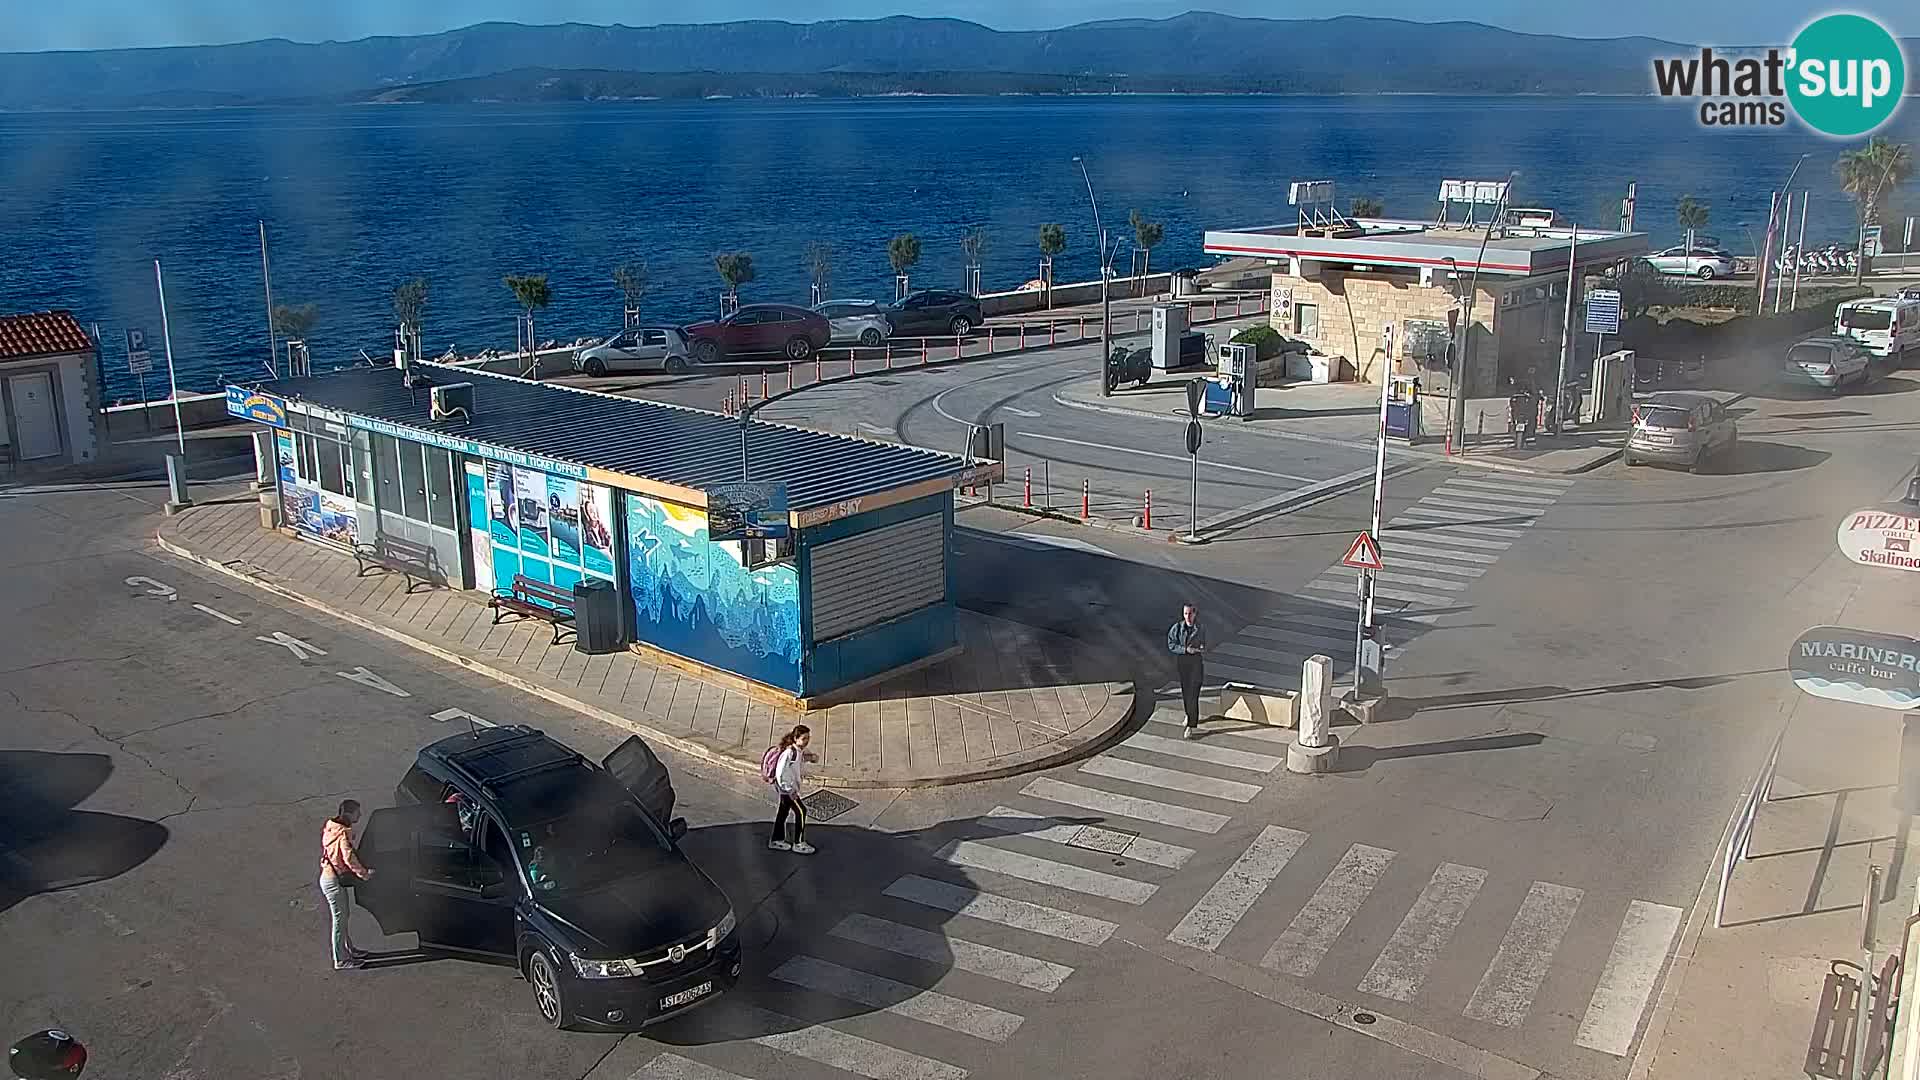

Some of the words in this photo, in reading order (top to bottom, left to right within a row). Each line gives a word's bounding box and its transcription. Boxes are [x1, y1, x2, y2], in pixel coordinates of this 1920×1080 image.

[131, 330, 144, 349] P
[437, 435, 469, 451] POSTAJA
[478, 444, 494, 457] BUS
[494, 448, 527, 465] STATION
[529, 456, 556, 470] TICKET
[556, 463, 583, 476] OFFICE
[1848, 515, 1920, 532] PIZZE
[1882, 530, 1917, 540] GRILL
[1829, 662, 1866, 675] caffe
[1870, 665, 1897, 680] bar
